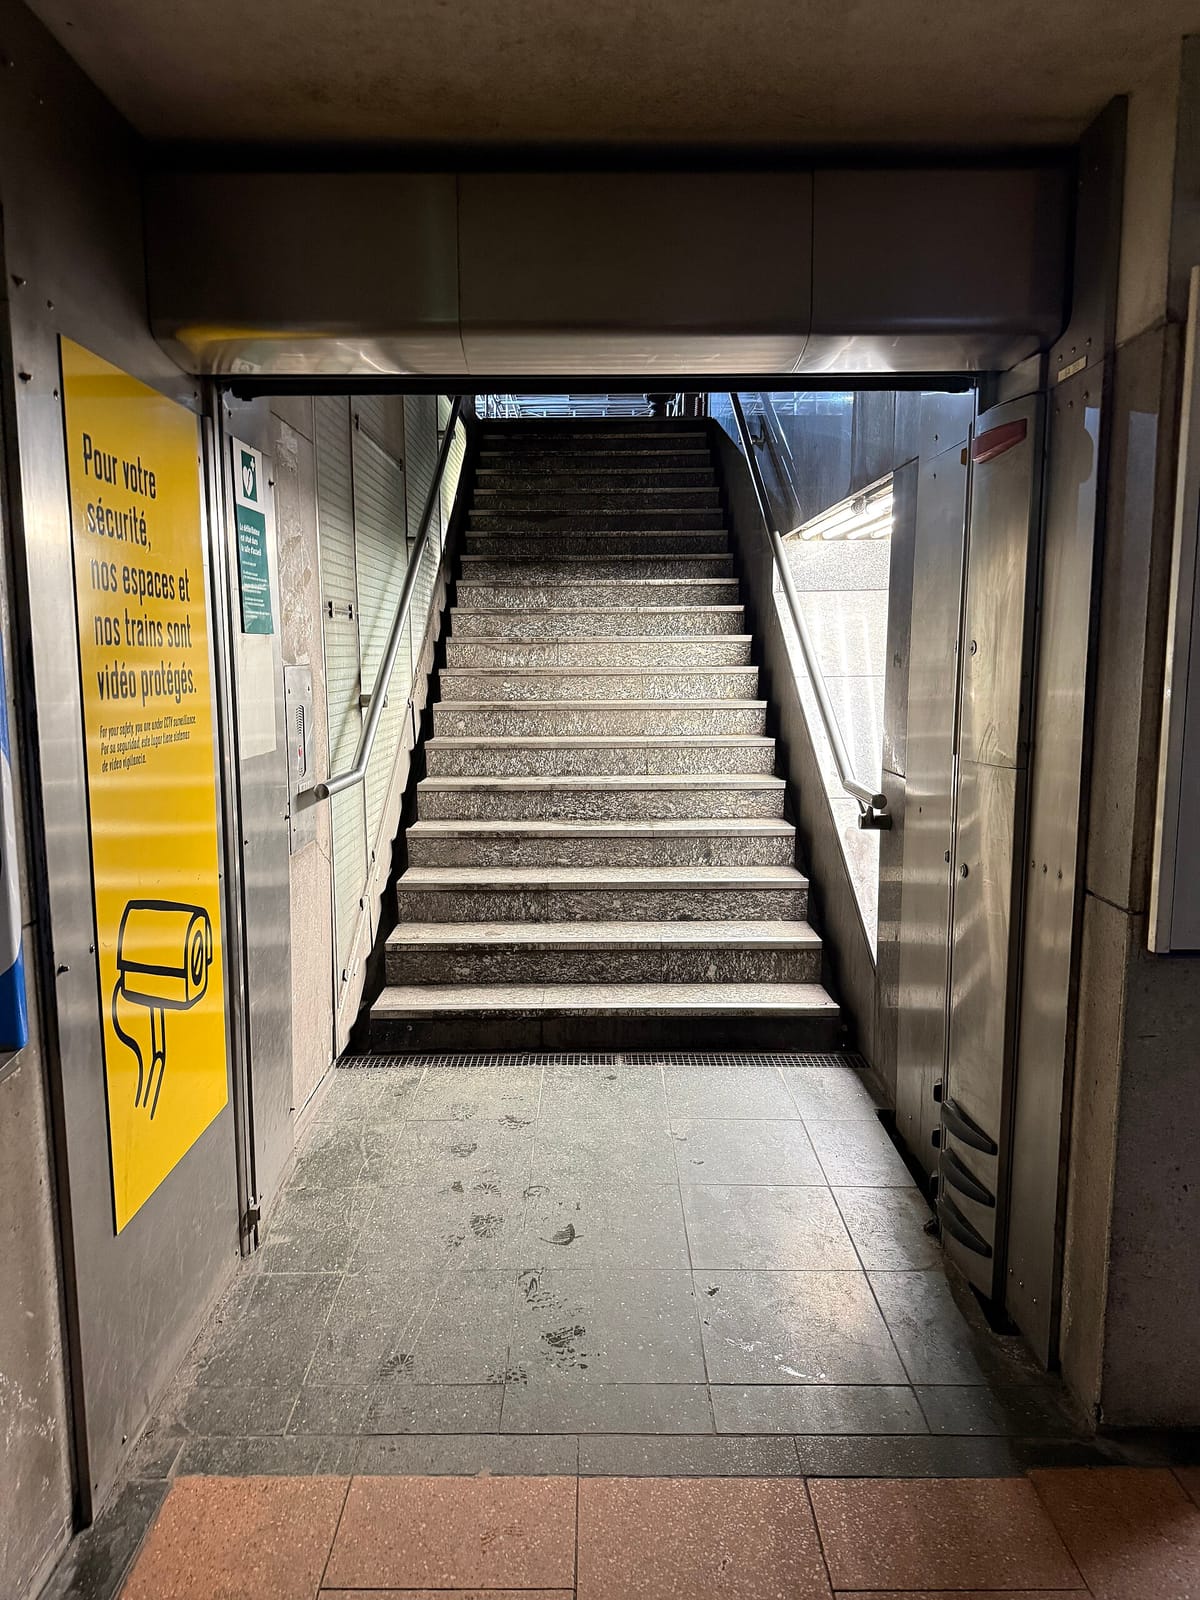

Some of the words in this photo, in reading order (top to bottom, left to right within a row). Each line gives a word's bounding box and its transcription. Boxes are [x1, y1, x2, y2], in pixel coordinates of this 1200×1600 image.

[83, 432, 118, 486] Pour
[122, 456, 156, 499] votre
[87, 497, 151, 551] sécurité,
[90, 558, 118, 592] nos
[122, 565, 175, 606] espaces
[179, 567, 190, 602] et
[94, 614, 121, 646] nos
[124, 608, 163, 648] trains
[167, 614, 192, 648] sont
[97, 660, 137, 700] vidéo
[141, 660, 197, 707] protégés.
[100, 725, 108, 738] For
[108, 726, 119, 740] your
[135, 723, 143, 736] you
[143, 721, 151, 732] are
[152, 718, 163, 730] under
[164, 716, 173, 728] CCTV
[101, 742, 109, 755] Por
[110, 743, 116, 754] su
[141, 735, 150, 748] este
[151, 734, 162, 748] lugar
[163, 732, 173, 744] tiene
[173, 729, 190, 742] sistemas
[102, 759, 108, 773] de
